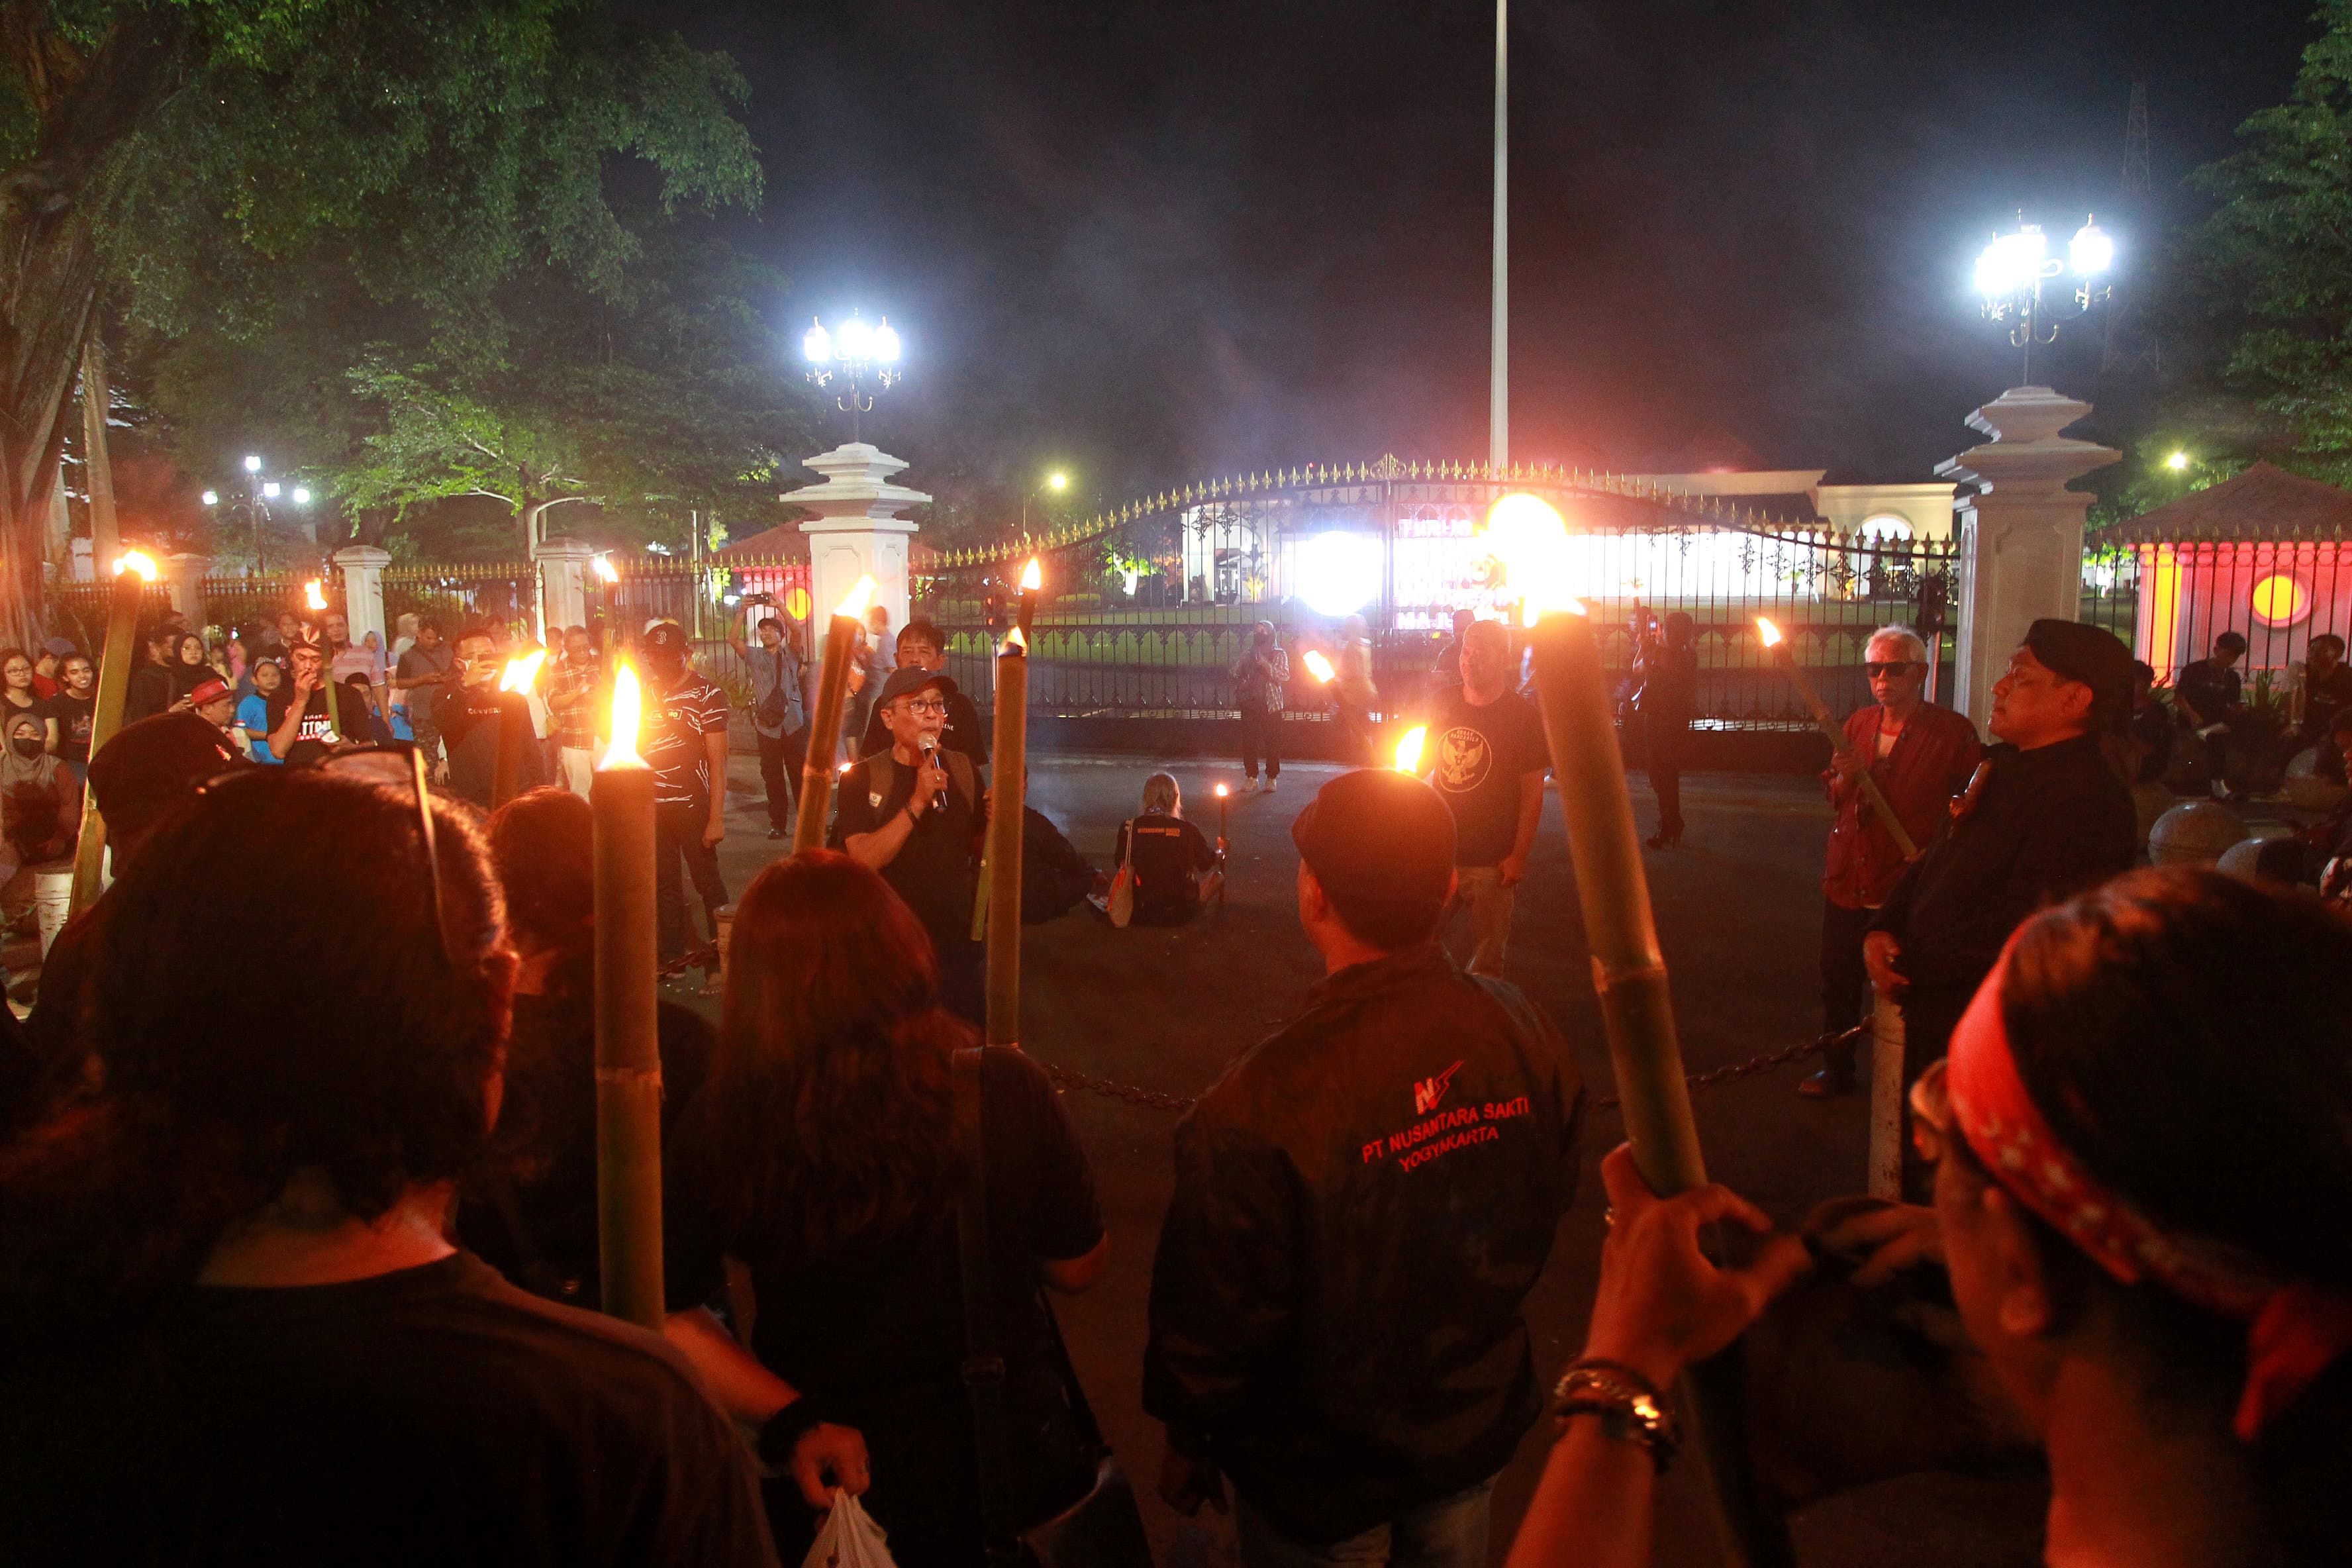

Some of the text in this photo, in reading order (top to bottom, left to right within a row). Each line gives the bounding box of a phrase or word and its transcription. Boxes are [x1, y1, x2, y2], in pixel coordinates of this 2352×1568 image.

[1362, 1097, 1530, 1163] PT NUSANTARA SAKTI
[1398, 1126, 1499, 1173] YOGYAKARTA
